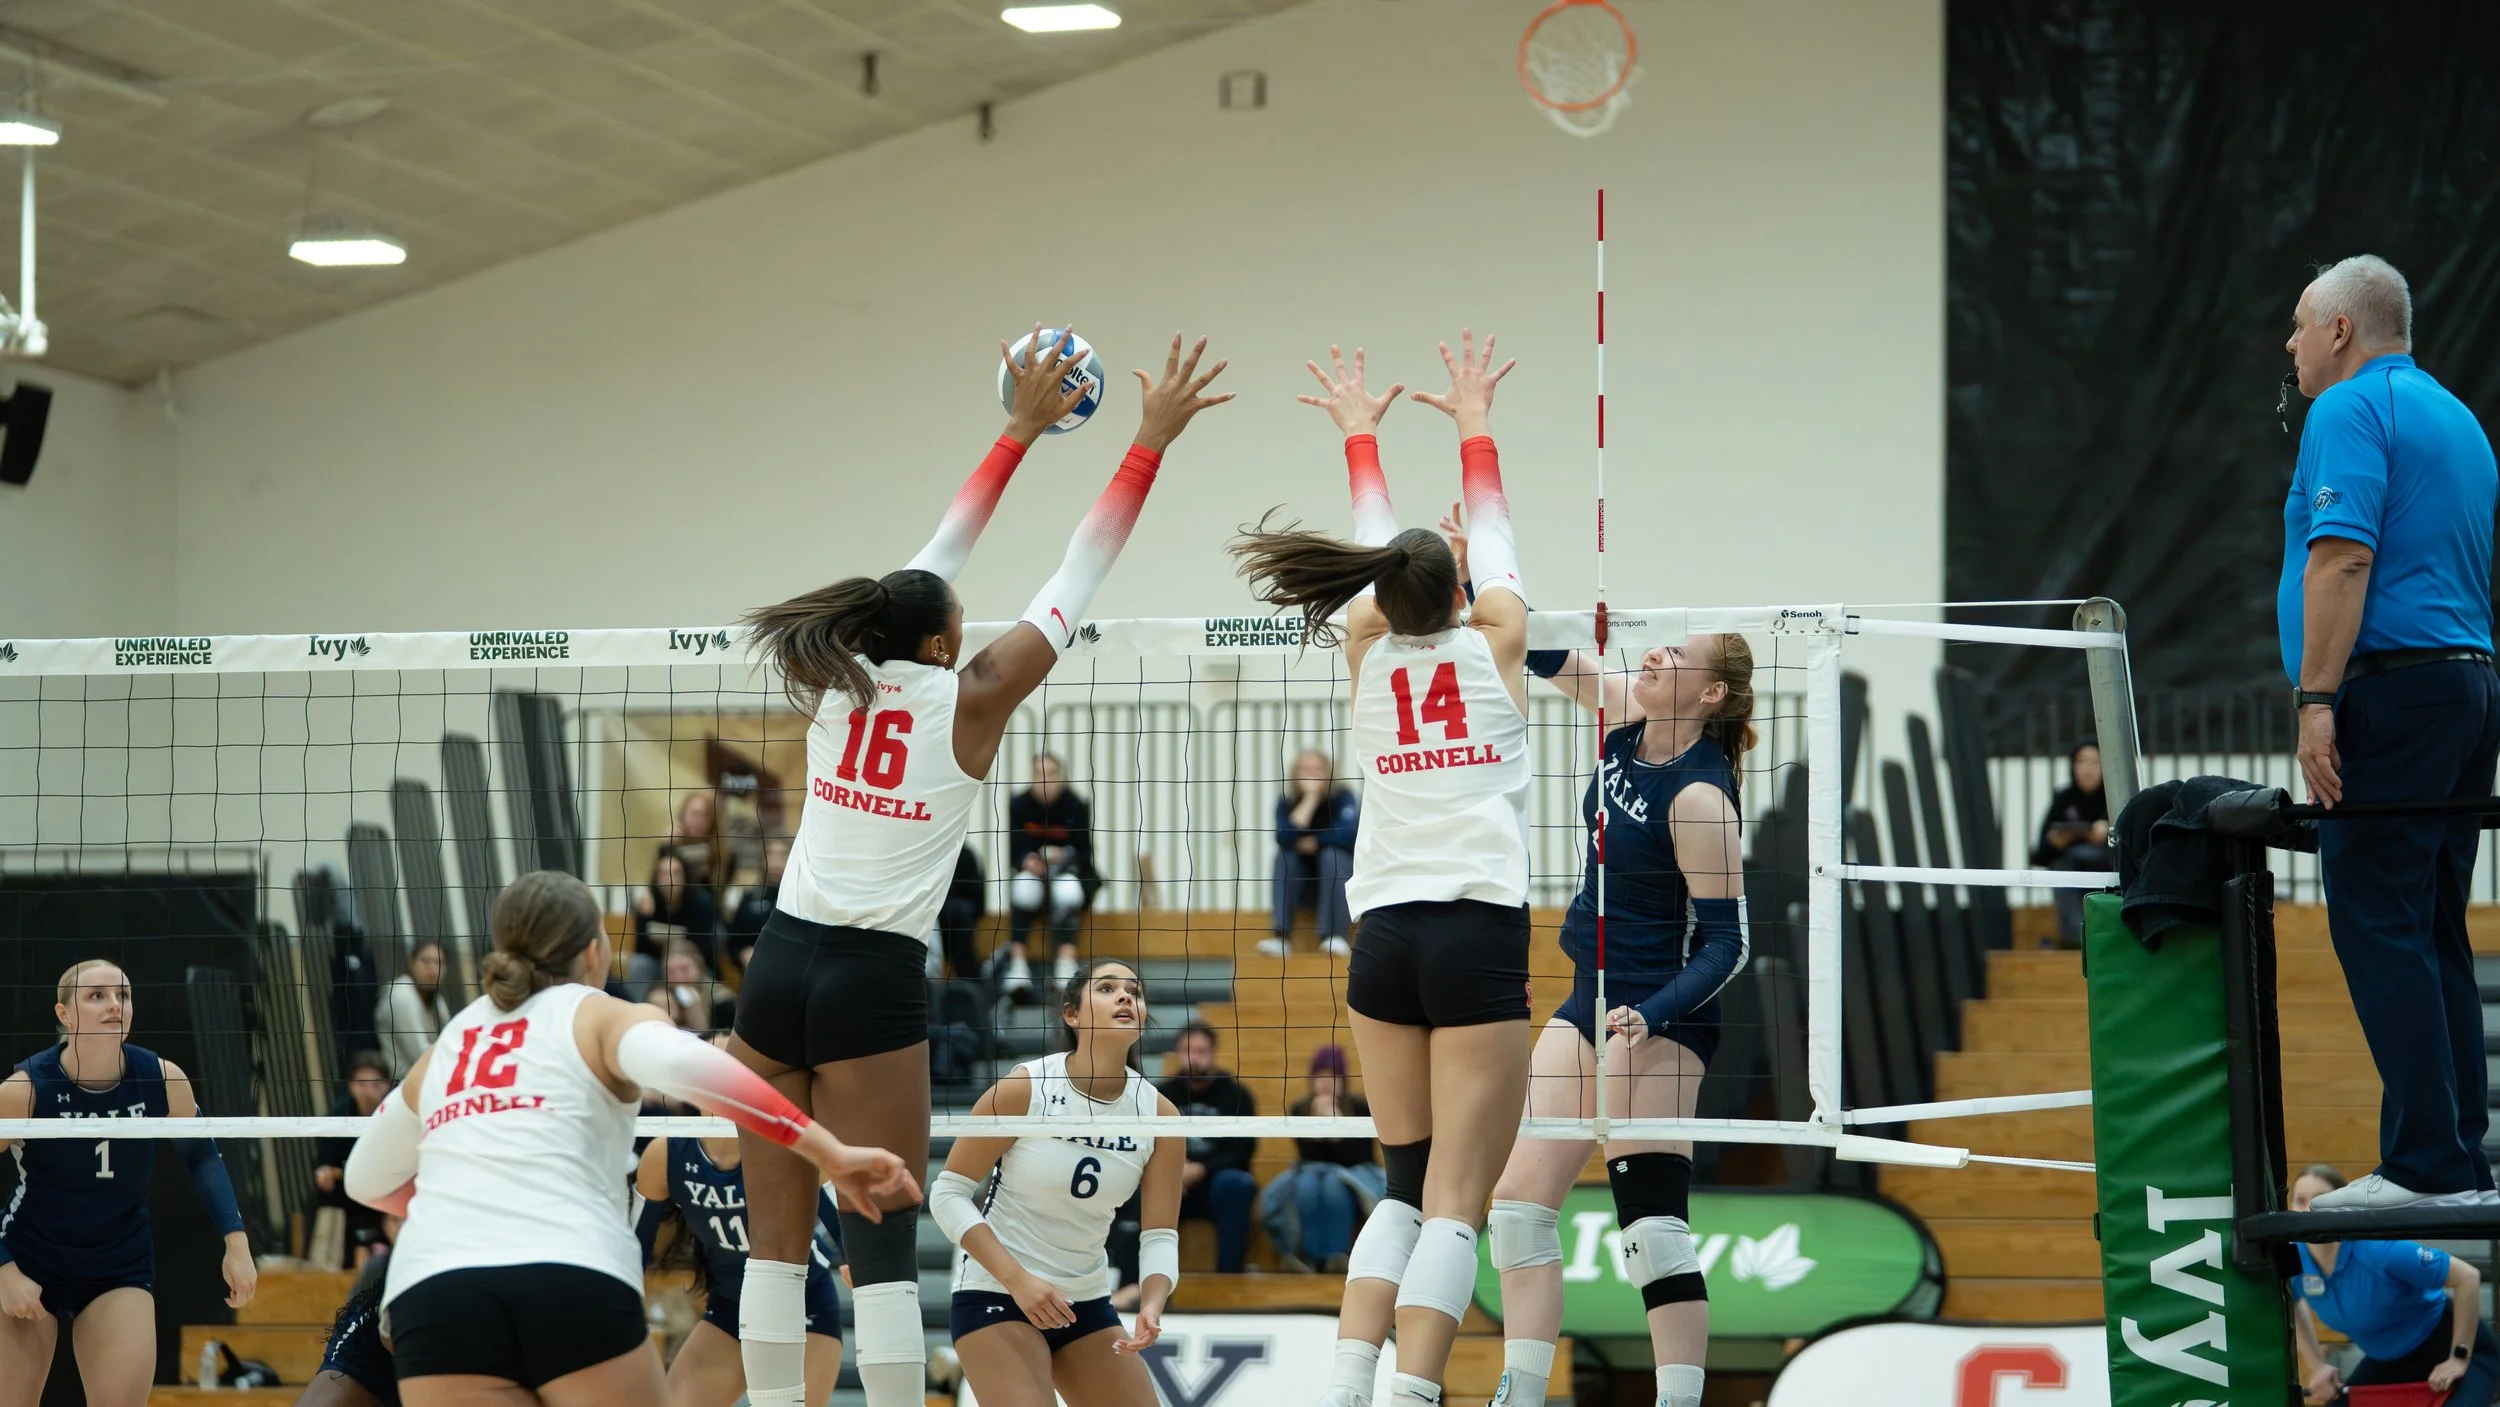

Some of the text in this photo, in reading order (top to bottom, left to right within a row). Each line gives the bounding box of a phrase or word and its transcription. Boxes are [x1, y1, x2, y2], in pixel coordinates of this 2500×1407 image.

[1205, 617, 1307, 632] UNRIVALED
[1621, 620, 1647, 628] imports
[1790, 610, 1822, 618] Senoh
[115, 638, 212, 651] UNRIVALED
[308, 635, 348, 661] Ivy
[469, 631, 569, 646] UNRIVALED
[669, 629, 709, 656] Ivy
[115, 652, 212, 665] EXPERIENCE
[470, 646, 570, 660] EXPERIENCE
[876, 680, 895, 694] Ivy
[1390, 661, 1468, 745] 14
[836, 706, 914, 790] 16
[1376, 744, 1501, 774] CORNELL
[814, 777, 932, 821] CORNELL
[446, 1017, 528, 1097] 12
[95, 1140, 114, 1178] 1
[1070, 1156, 1101, 1199] 6
[684, 1180, 746, 1209] YAL
[708, 1215, 751, 1252] 11
[2120, 1183, 2233, 1388] Ivy
